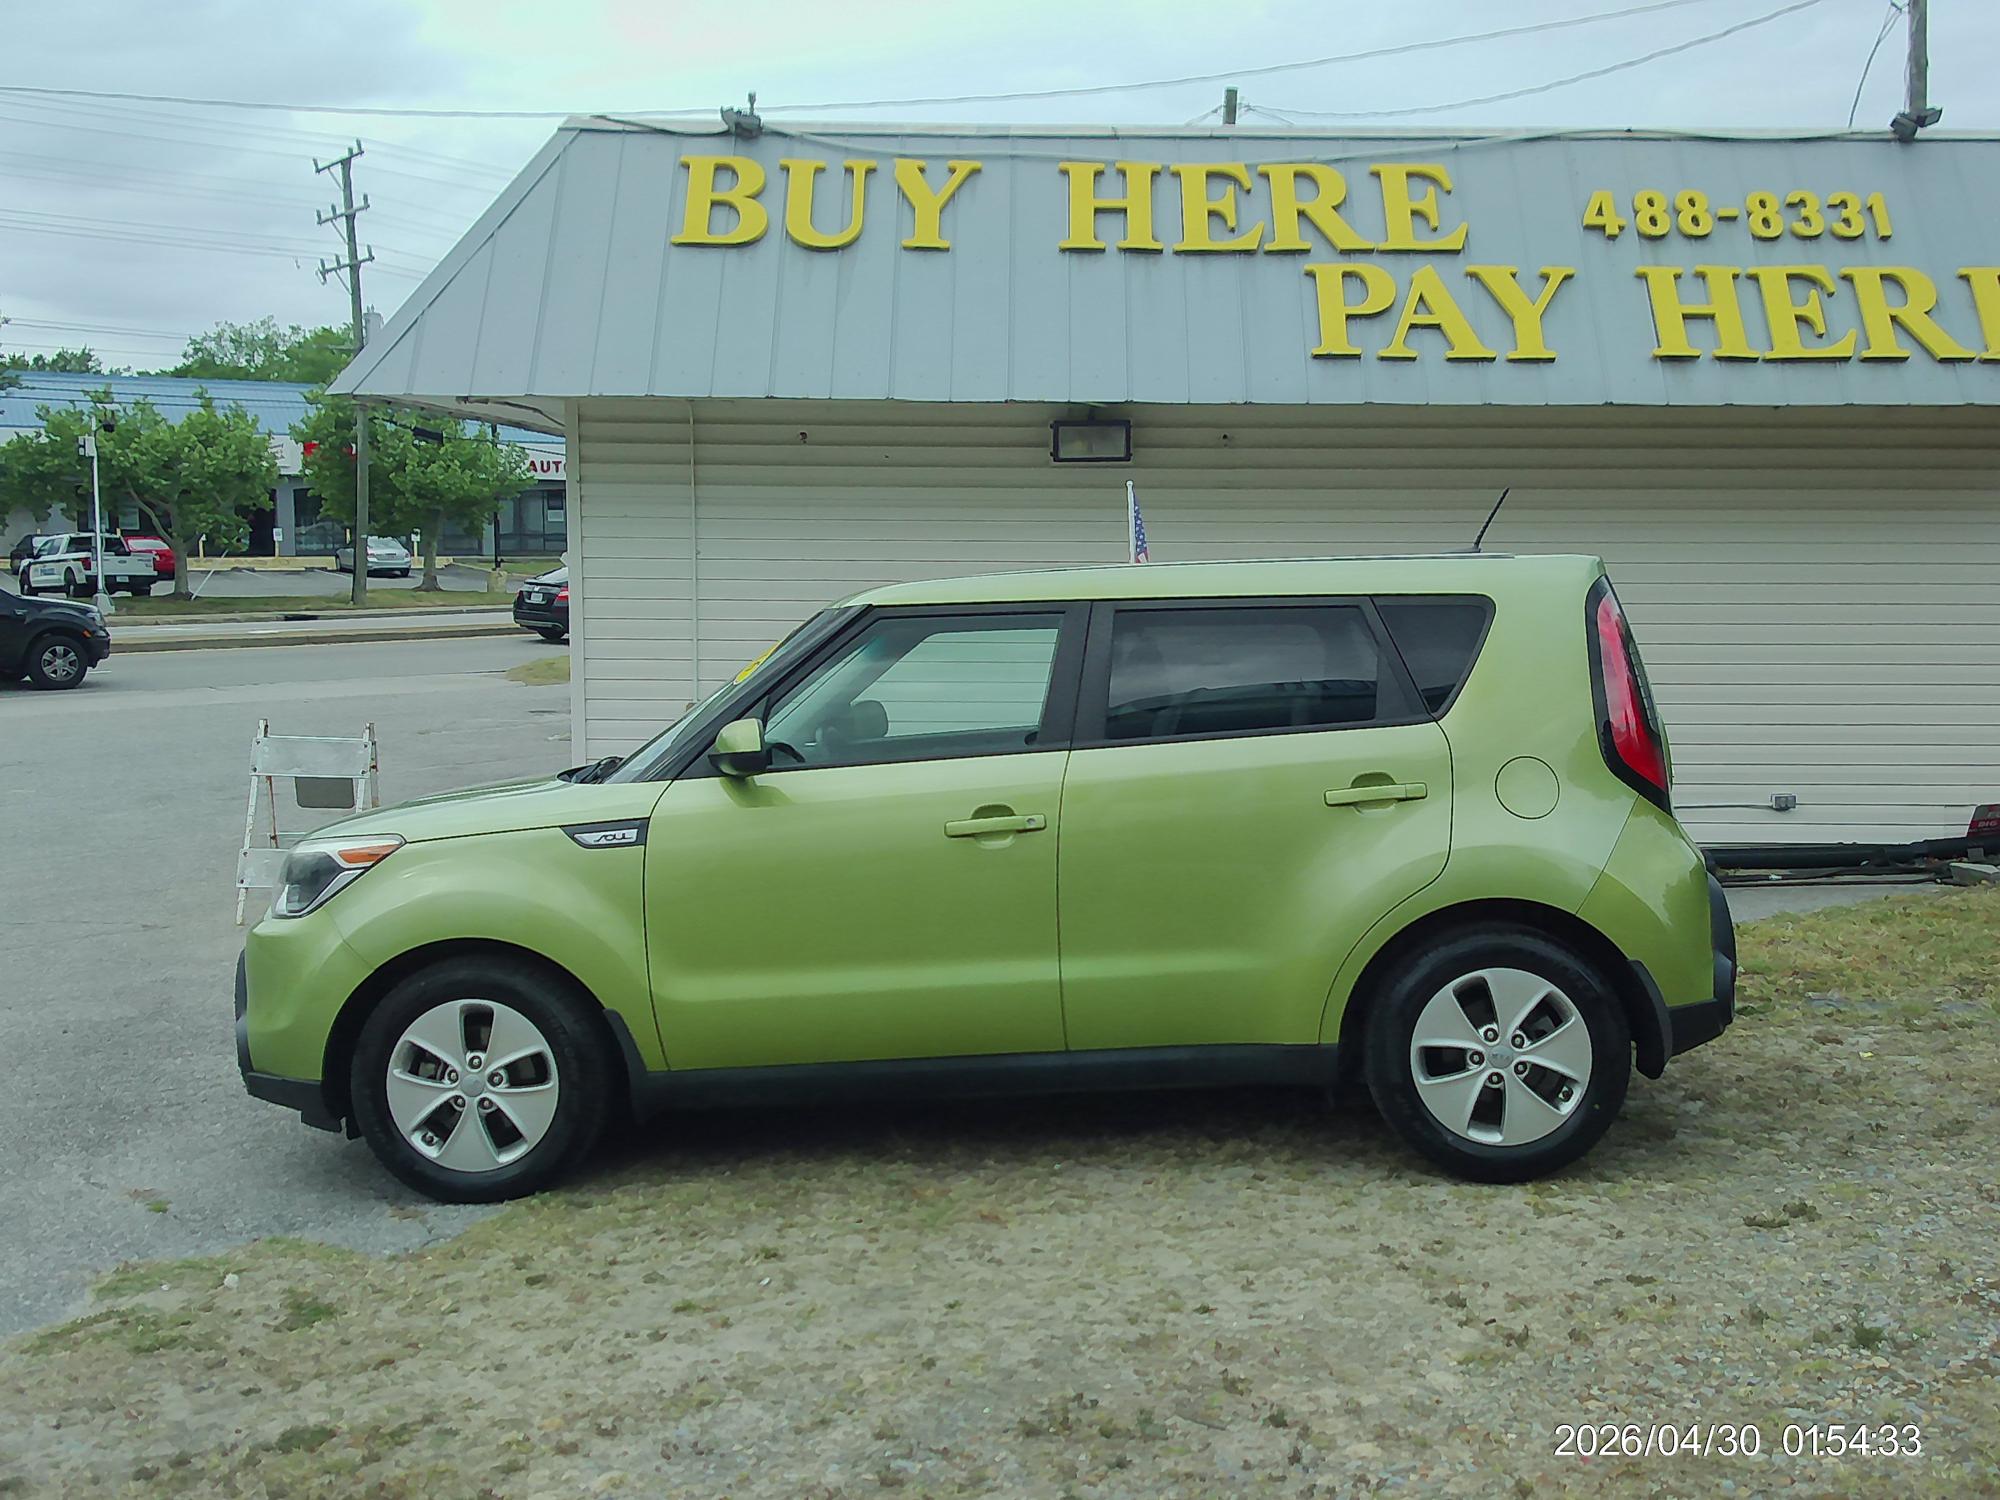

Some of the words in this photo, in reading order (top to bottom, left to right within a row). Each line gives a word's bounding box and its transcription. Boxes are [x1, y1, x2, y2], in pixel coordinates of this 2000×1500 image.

[671, 156, 982, 251] BUY
[1058, 160, 1468, 253] HERE
[1582, 190, 1893, 239] 488-8331
[1304, 263, 1575, 361] PAY
[529, 460, 566, 473] AUT
